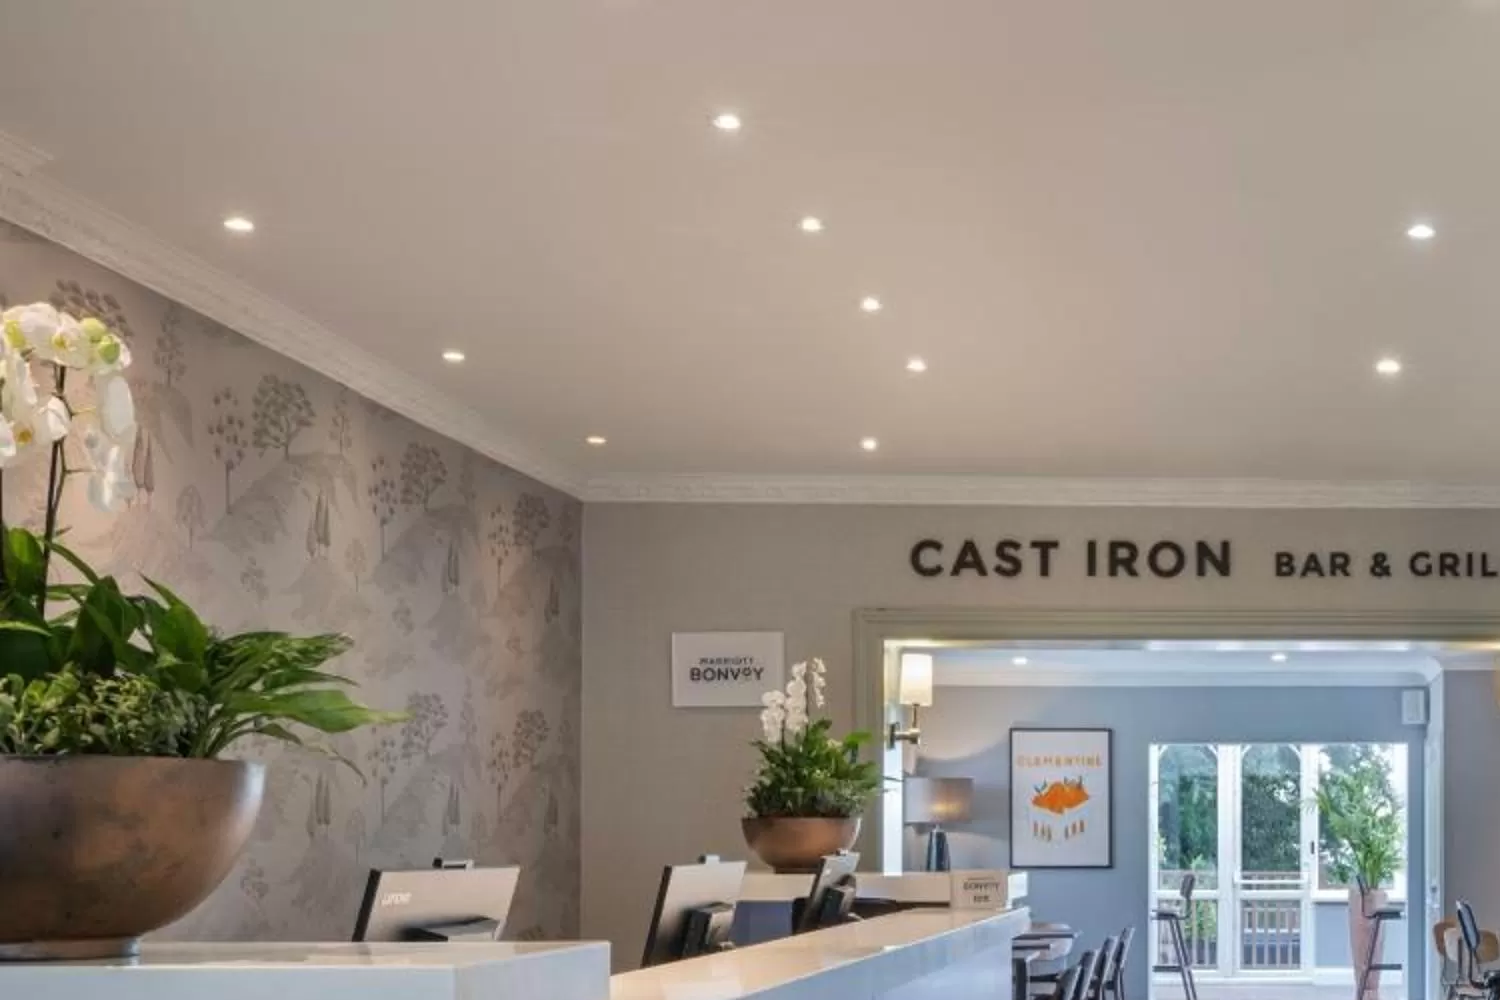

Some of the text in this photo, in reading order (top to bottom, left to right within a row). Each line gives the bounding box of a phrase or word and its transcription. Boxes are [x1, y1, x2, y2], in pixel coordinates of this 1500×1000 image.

[908, 538, 1060, 578] CAST
[1086, 538, 1232, 578] IRON
[1274, 550, 1352, 579] BAR
[1369, 550, 1394, 580] &
[689, 667, 764, 681] BONVOY
